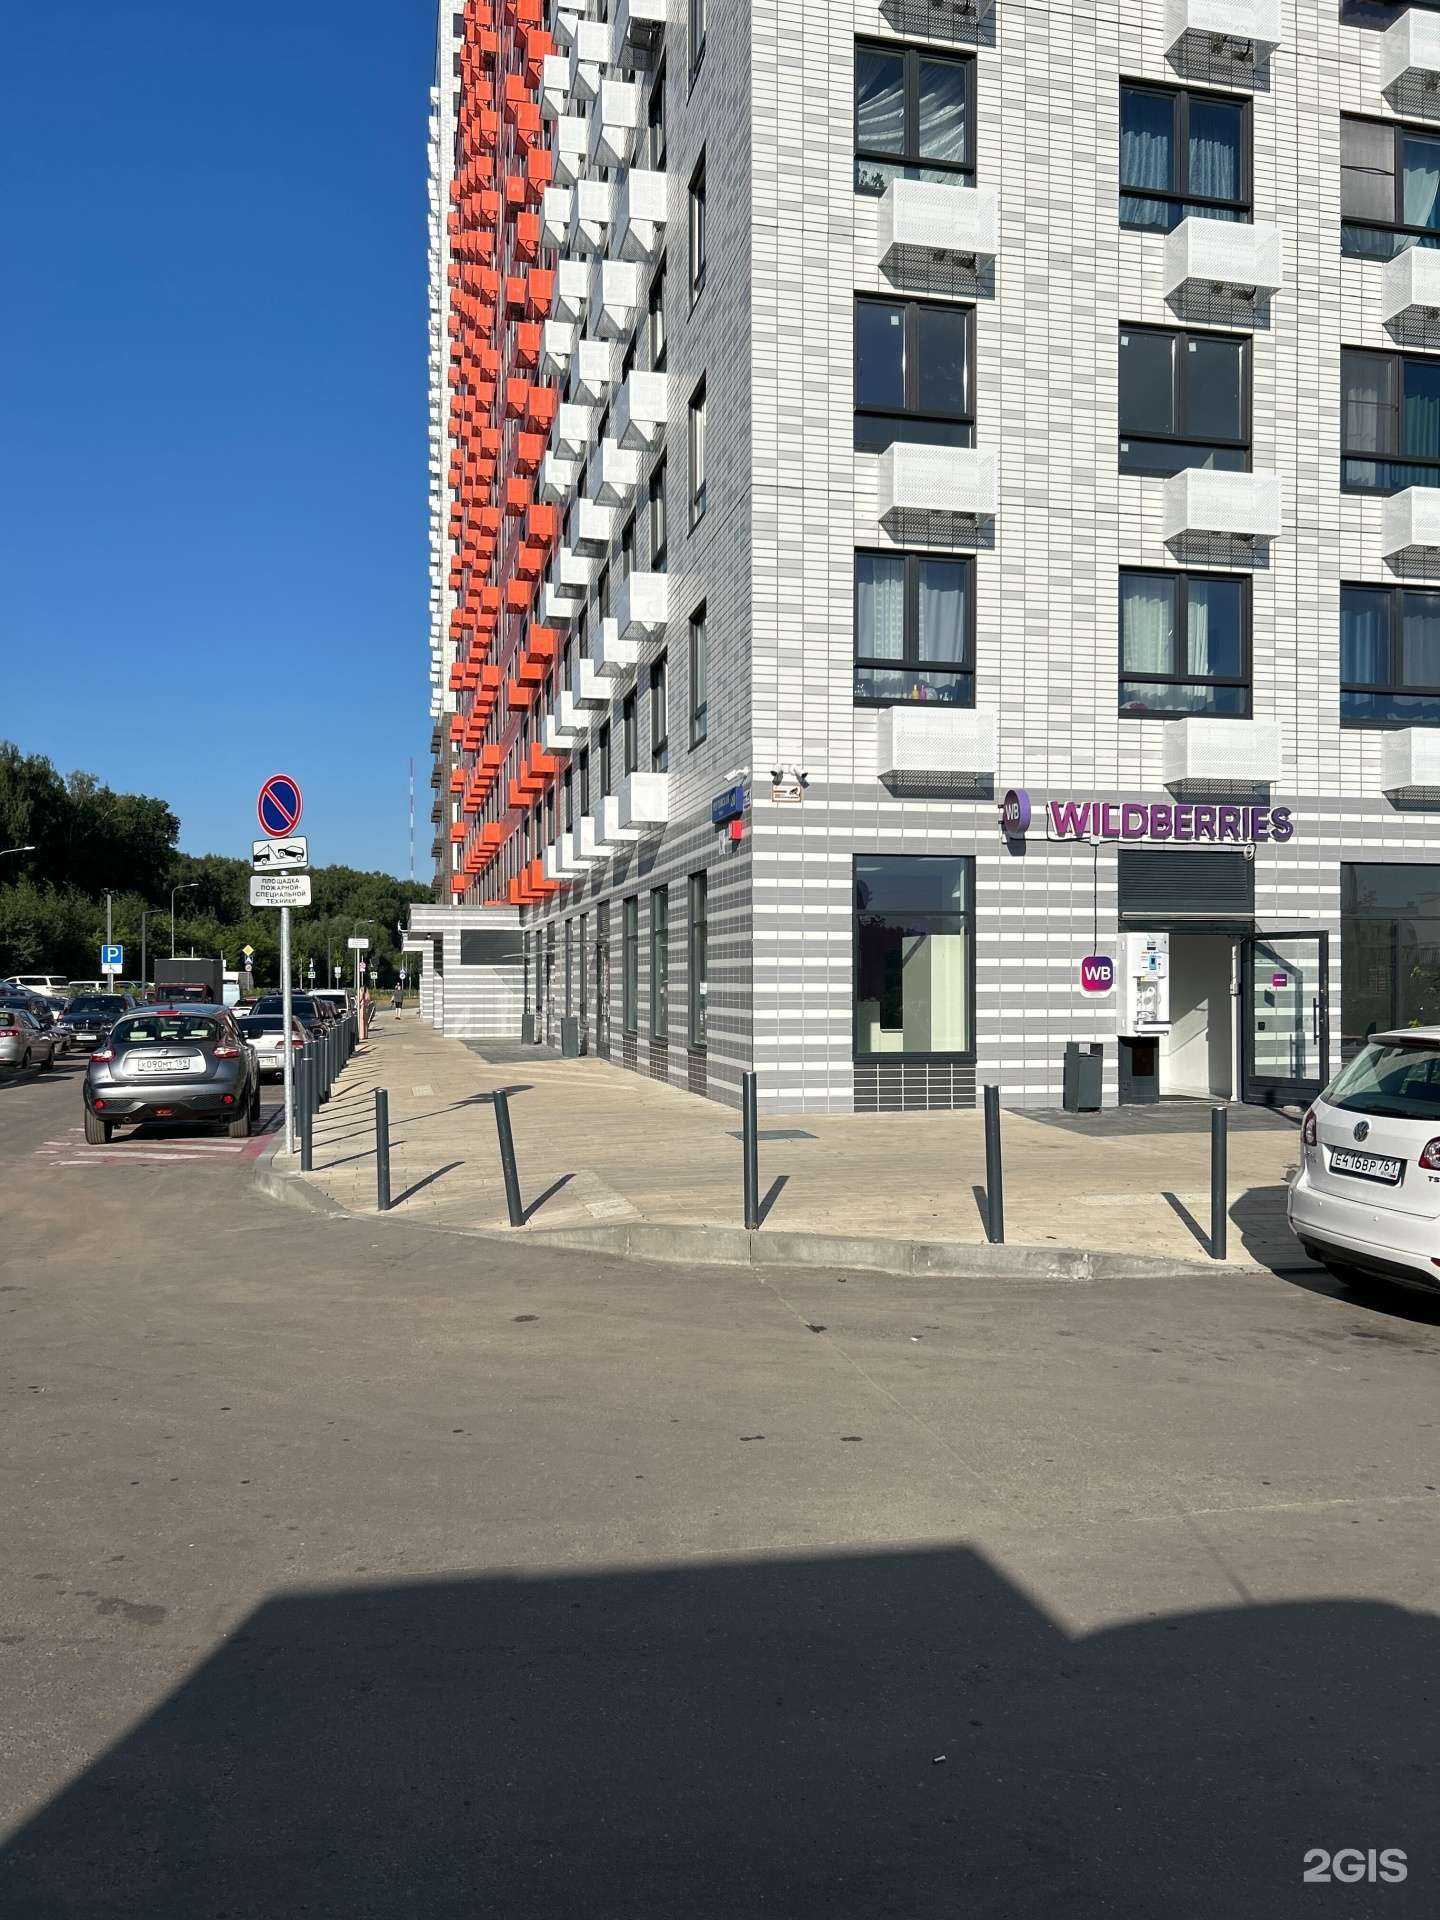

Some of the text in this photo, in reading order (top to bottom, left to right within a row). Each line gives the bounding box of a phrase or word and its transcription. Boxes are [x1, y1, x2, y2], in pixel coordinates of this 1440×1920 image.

[1005, 803, 1020, 820] WB
[1050, 800, 1294, 842] WILDBERRIES
[255, 890, 306, 898] СПЕЦИАЛЬНОЙ
[107, 947, 119, 963] P
[1084, 966, 1111, 981] WB
